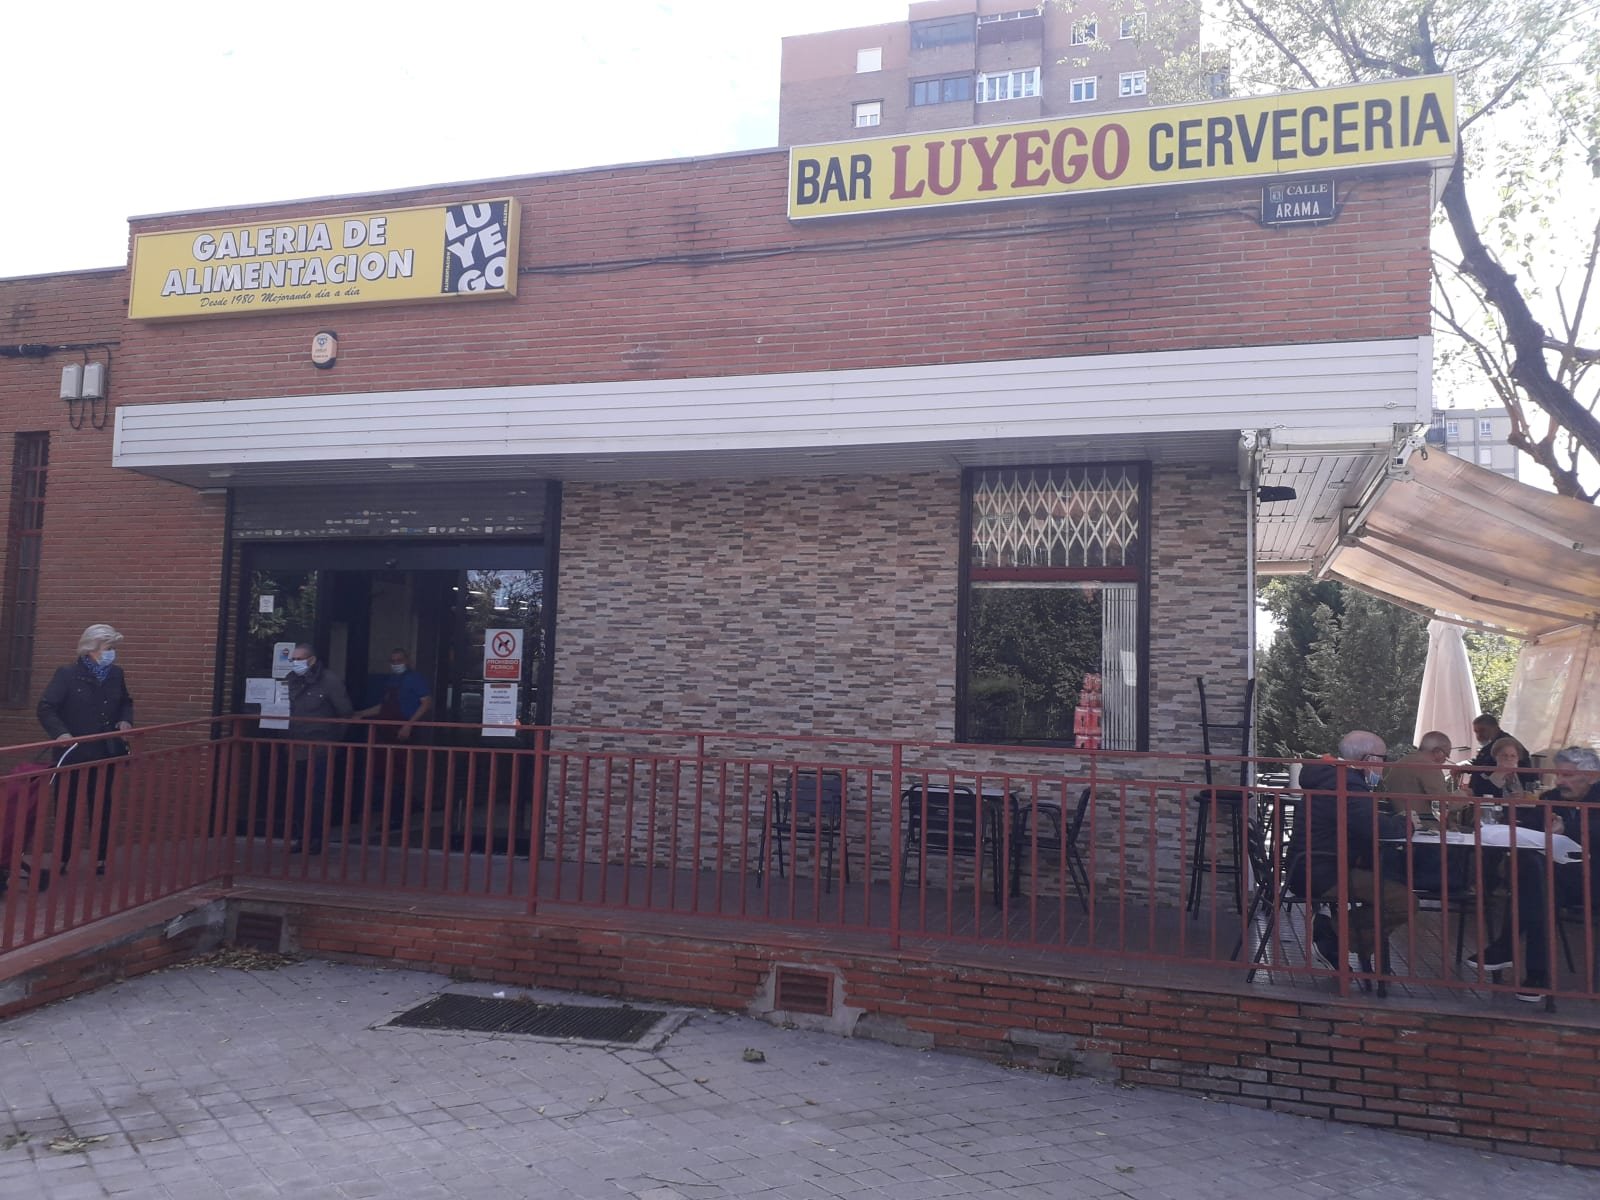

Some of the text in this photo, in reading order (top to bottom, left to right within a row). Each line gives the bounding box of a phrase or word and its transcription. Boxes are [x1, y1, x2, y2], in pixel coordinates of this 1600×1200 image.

[798, 92, 1450, 206] BAR LUYEGO CERVECERIA
[1286, 183, 1328, 196] CALLE
[1276, 200, 1320, 218] ARAMA
[192, 217, 388, 261] GALERIA DE
[160, 249, 413, 297] ALIMENTACION
[200, 297, 228, 308] Desde
[230, 294, 256, 305] 1980
[261, 292, 313, 304] Mejorando
